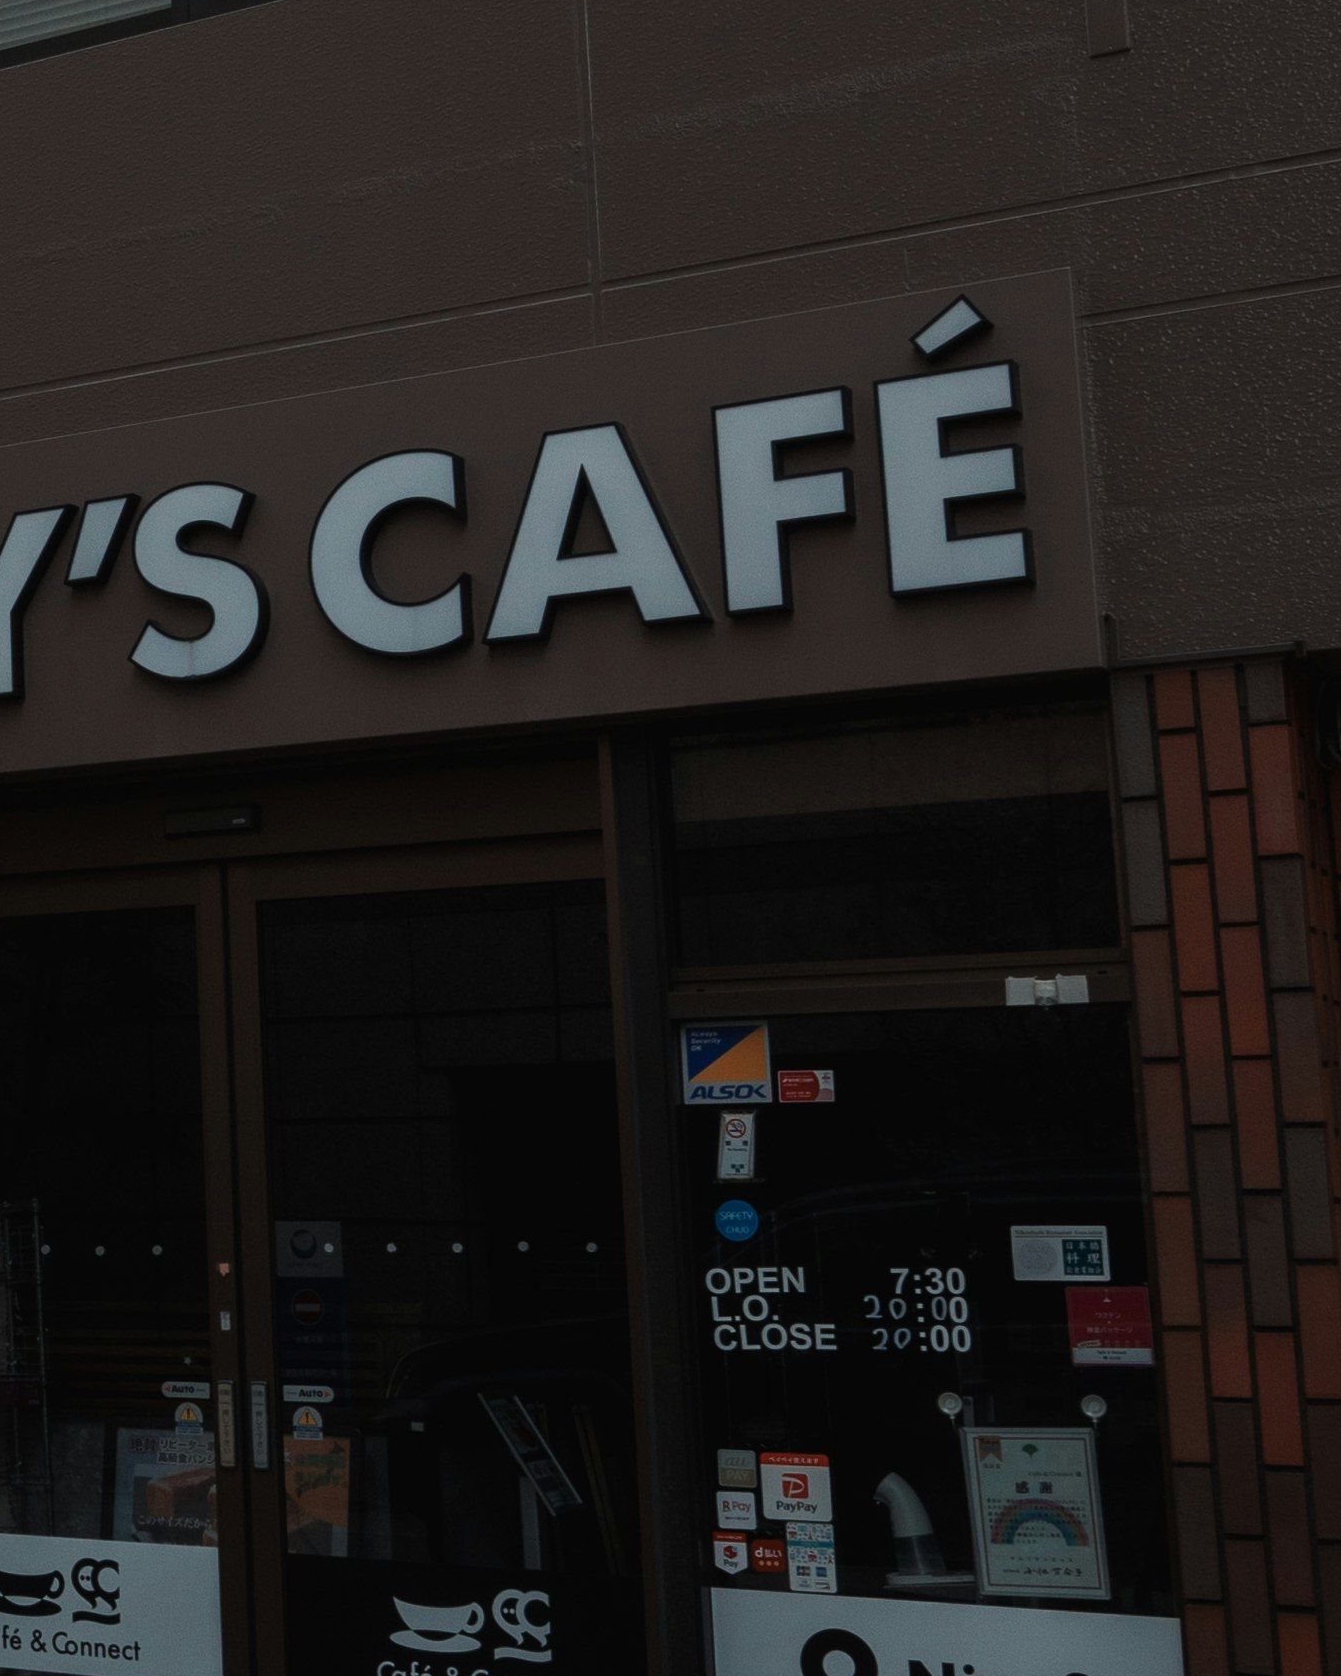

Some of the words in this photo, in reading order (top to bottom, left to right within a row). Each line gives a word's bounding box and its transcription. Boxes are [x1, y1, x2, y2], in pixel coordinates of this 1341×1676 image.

[309, 294, 1035, 658] CAFÉ
[690, 1084, 767, 1100] ALSOK
[719, 1210, 754, 1221] SAFETY
[1066, 1251, 1101, 1265] 料理
[705, 1266, 806, 1294] OPEN
[889, 1267, 966, 1295] 7:30
[710, 1294, 780, 1322] L.O.
[863, 1294, 968, 1323] 20:00
[713, 1323, 838, 1351] CLOSE
[872, 1324, 972, 1352] 20:00
[171, 1384, 195, 1394] Auto
[298, 1389, 323, 1398] Auto
[732, 1501, 751, 1513] Pay
[776, 1500, 818, 1514] PayPay
[30, 1629, 47, 1653] &
[52, 1631, 141, 1662] Connect
